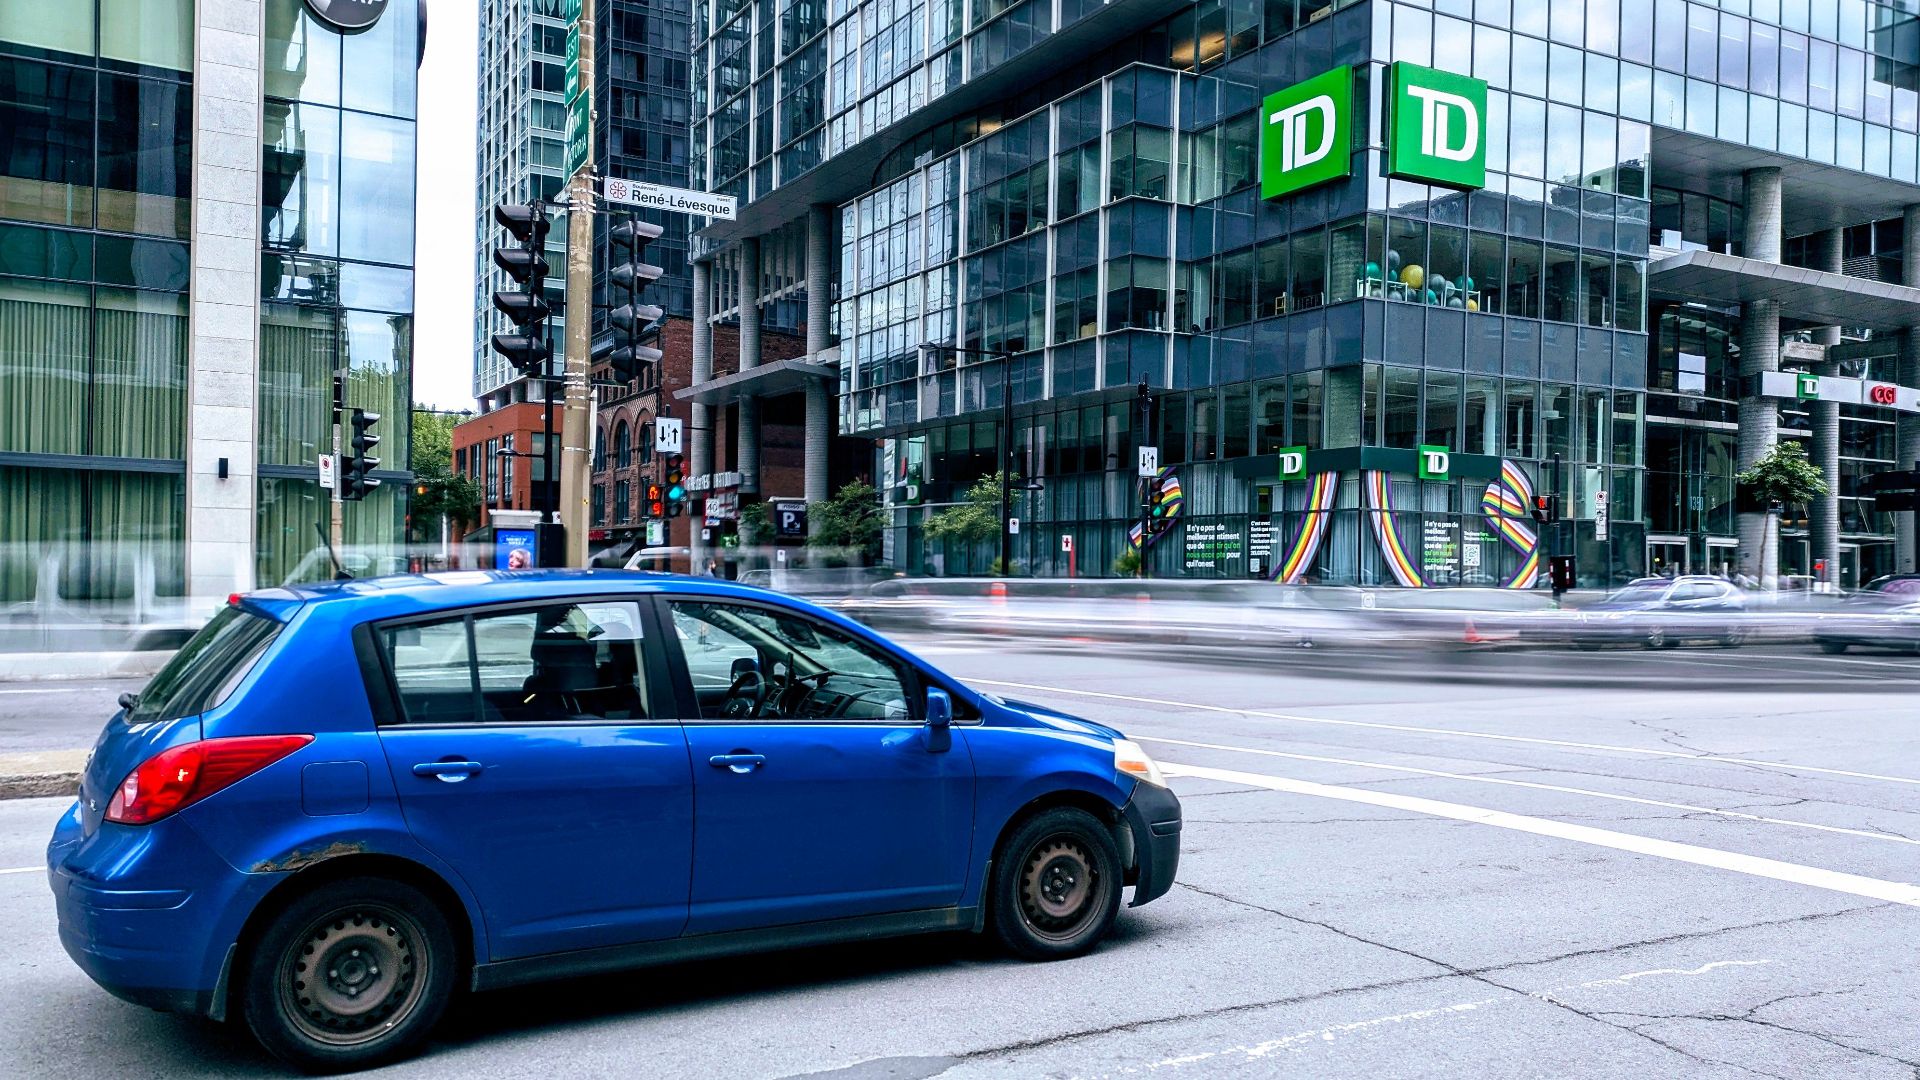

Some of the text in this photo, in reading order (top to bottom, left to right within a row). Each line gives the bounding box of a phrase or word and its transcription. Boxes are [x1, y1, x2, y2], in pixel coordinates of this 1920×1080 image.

[568, 35, 577, 60] EST
[1270, 95, 1336, 173] TD
[1407, 84, 1478, 162] TD
[631, 190, 730, 215] René-Lévesque
[1801, 378, 1819, 394] TD
[1871, 385, 1897, 405] CGI
[1279, 452, 1303, 474] TD
[1423, 450, 1449, 474] TD
[707, 503, 718, 513] 40
[783, 512, 795, 528] P
